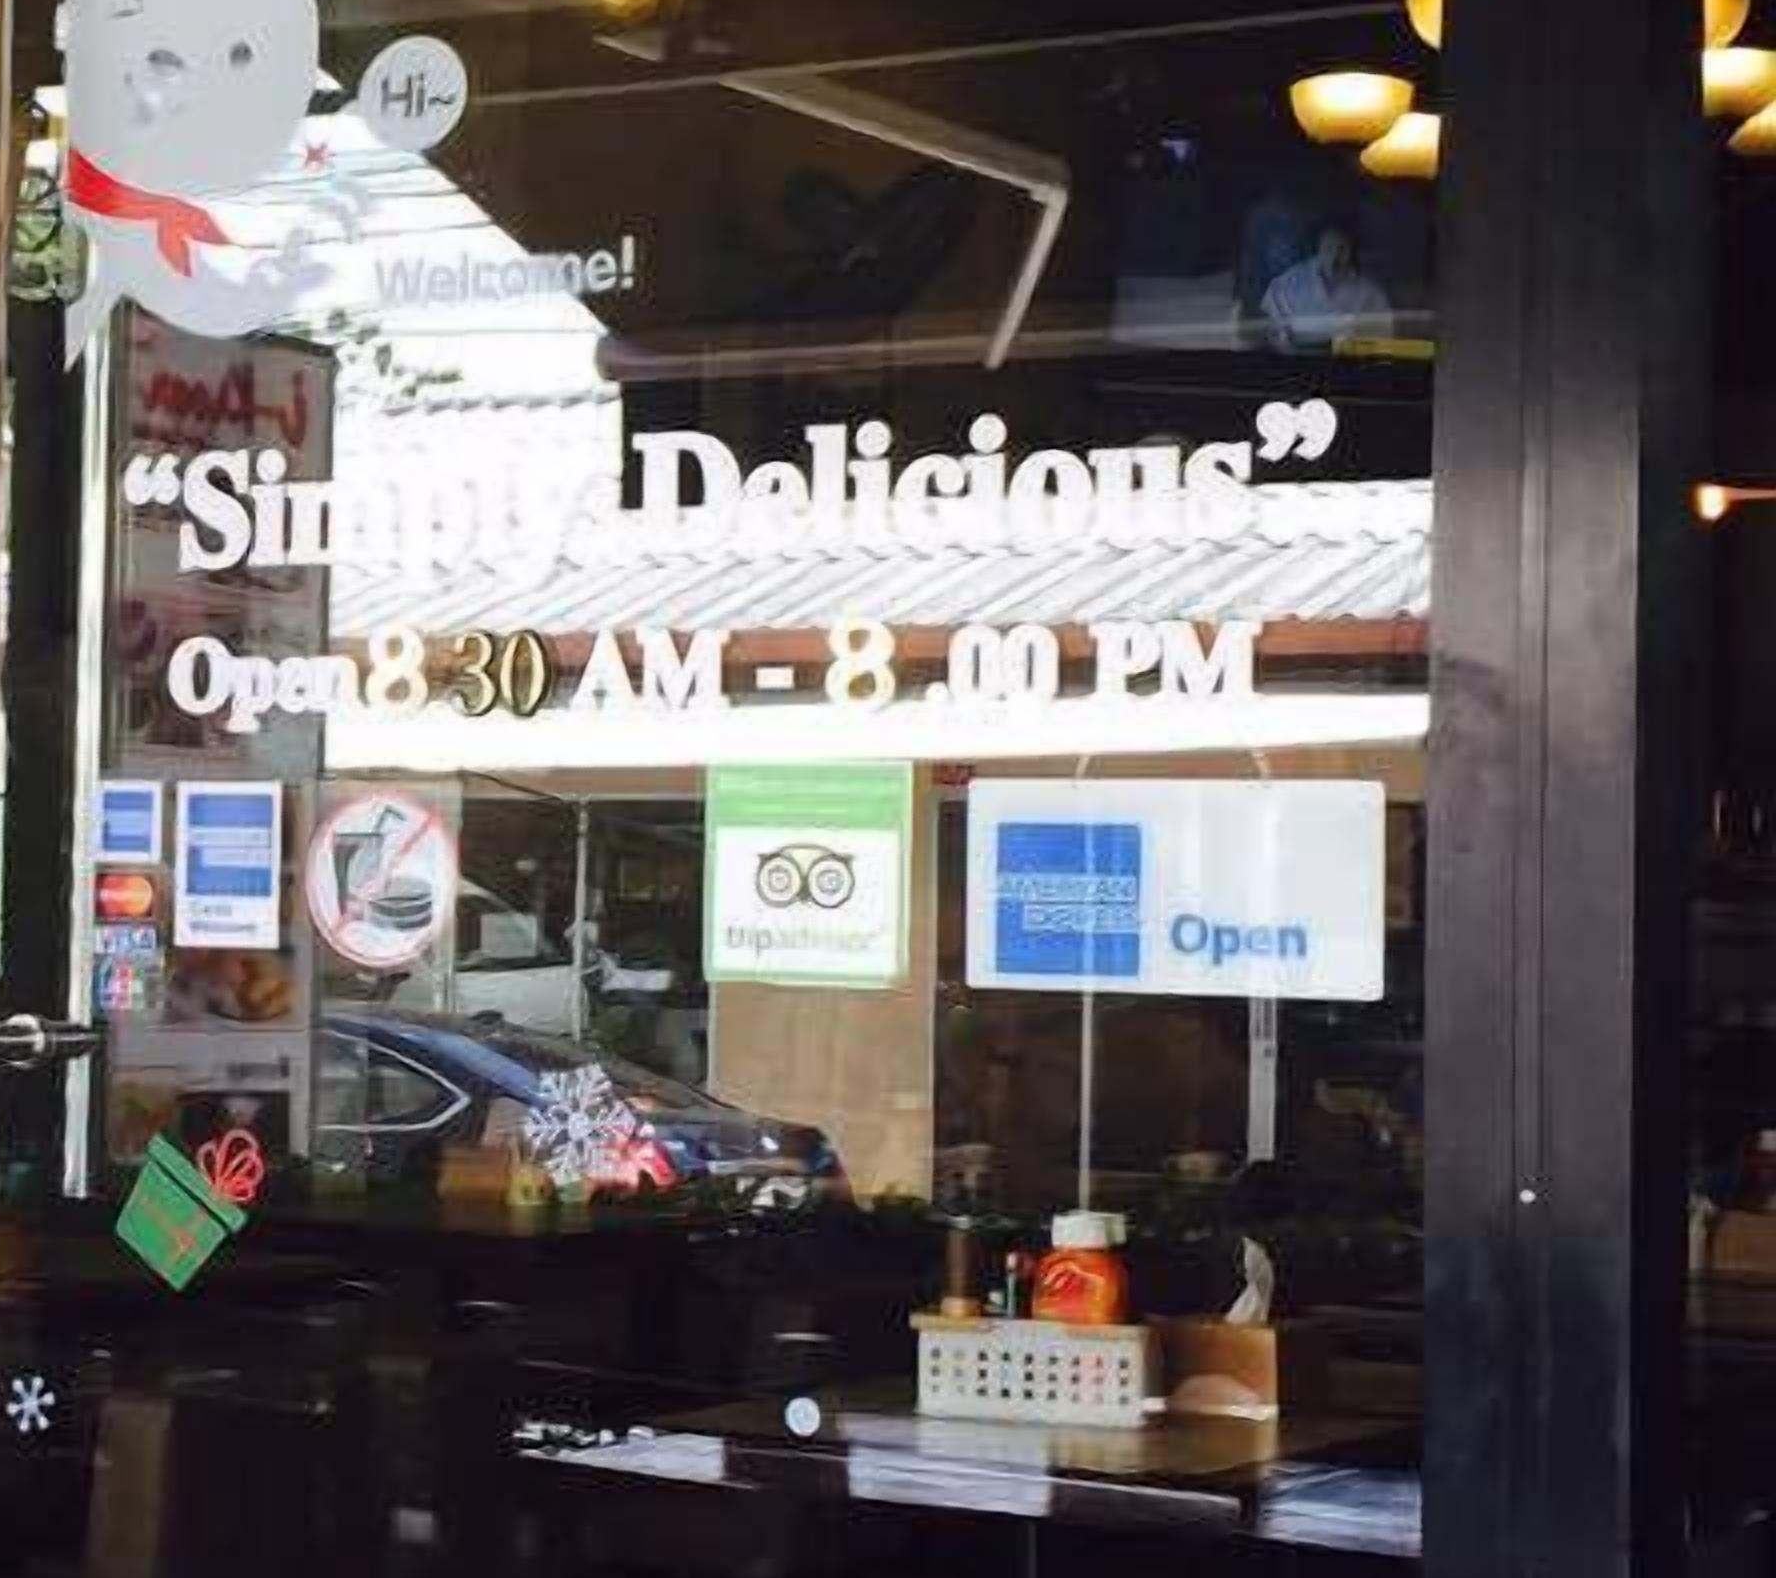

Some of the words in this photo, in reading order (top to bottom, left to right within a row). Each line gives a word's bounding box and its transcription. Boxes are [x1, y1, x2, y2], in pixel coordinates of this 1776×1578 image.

[167, 635, 359, 733] Open
[571, 625, 730, 709] AM
[1089, 619, 1264, 697] PM
[1170, 914, 1307, 966] Open
